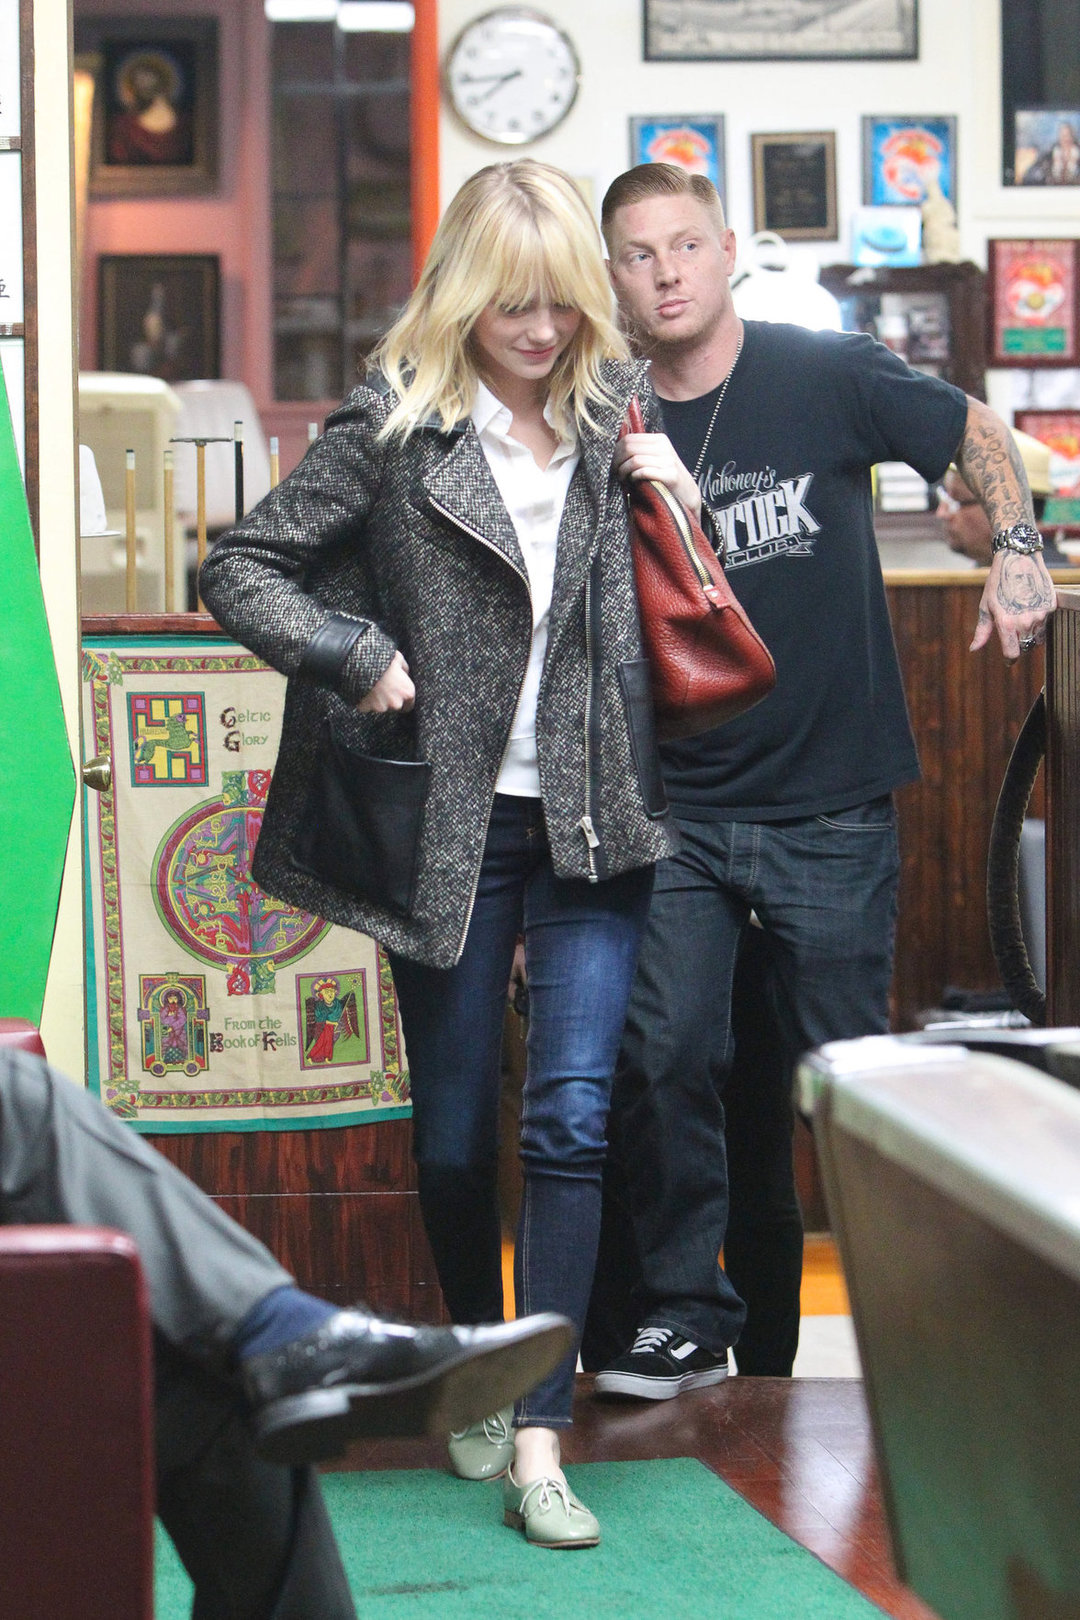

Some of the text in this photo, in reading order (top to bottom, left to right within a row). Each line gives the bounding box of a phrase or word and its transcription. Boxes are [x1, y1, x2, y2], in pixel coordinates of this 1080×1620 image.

[698, 461, 776, 503] Mahoney's
[220, 707, 271, 728] Celtic
[223, 730, 269, 752] Glory
[224, 1016, 282, 1031] From the
[209, 1032, 247, 1053] Book
[262, 1031, 297, 1051] Kells
